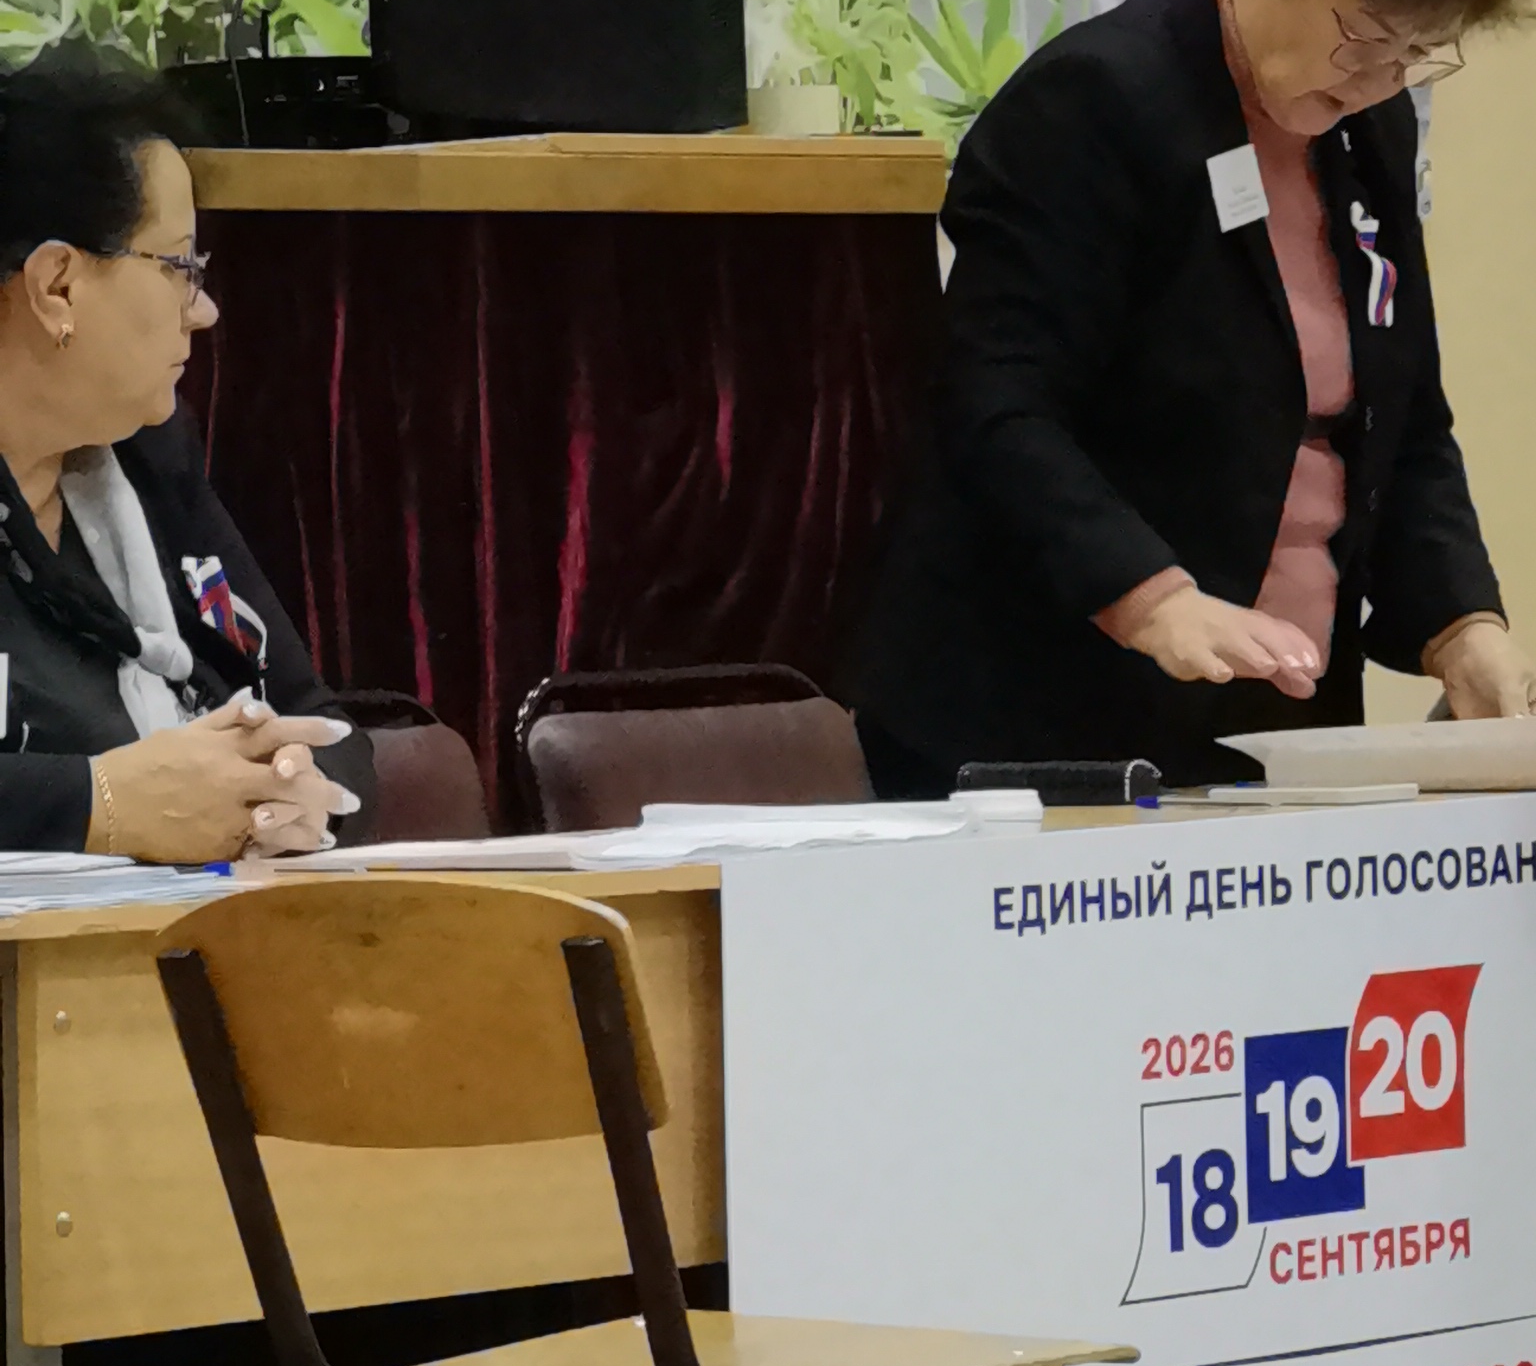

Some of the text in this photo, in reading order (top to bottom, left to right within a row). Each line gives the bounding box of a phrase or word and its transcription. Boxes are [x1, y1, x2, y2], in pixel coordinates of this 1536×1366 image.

[992, 858, 1173, 938] ЕДИНЫЙ
[1184, 862, 1294, 923] ДЕНЬ
[1139, 1029, 1235, 1081] 2026
[1154, 1009, 1458, 1254] 18 19 20
[1268, 1217, 1472, 1286] СЕНТЯБРЯ
